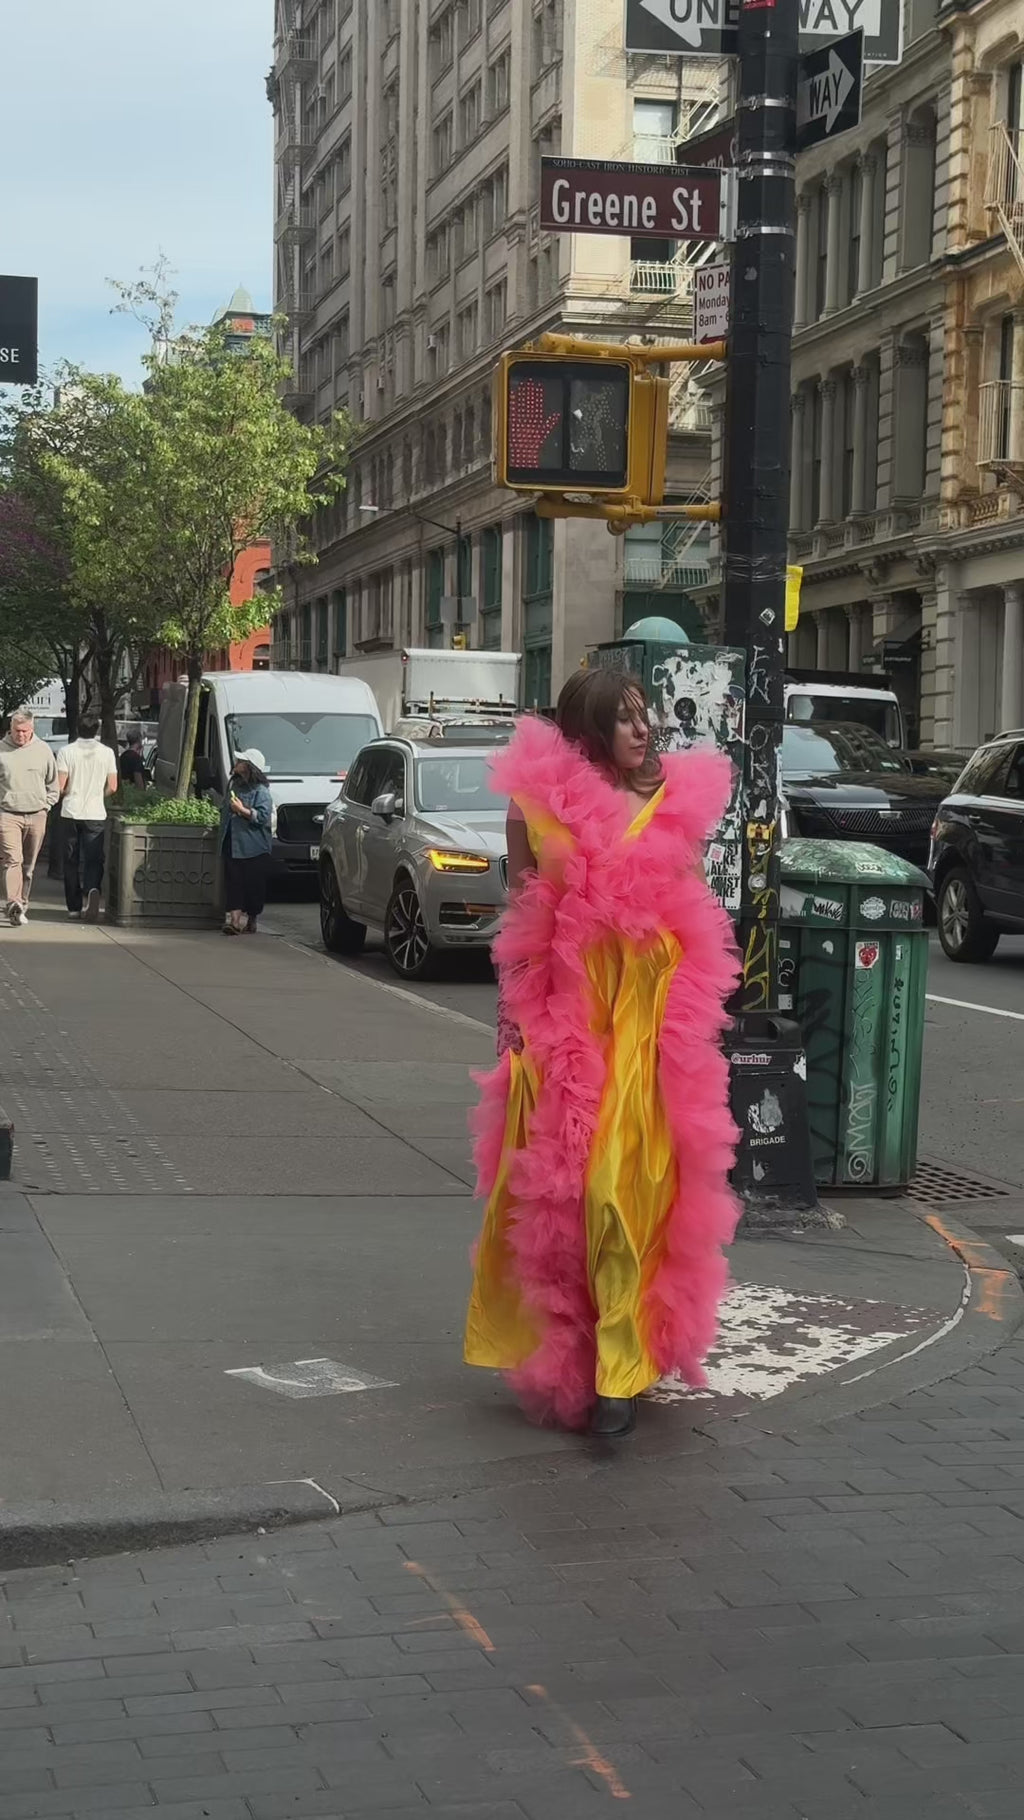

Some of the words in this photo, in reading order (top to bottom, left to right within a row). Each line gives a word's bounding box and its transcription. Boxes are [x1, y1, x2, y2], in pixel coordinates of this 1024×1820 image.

[809, 68, 844, 118] WAY
[552, 178, 657, 229] Greene
[671, 186, 702, 232] St
[699, 274, 714, 292] NO
[699, 314, 717, 328] 8am
[750, 1135, 786, 1147] BRIGADE
